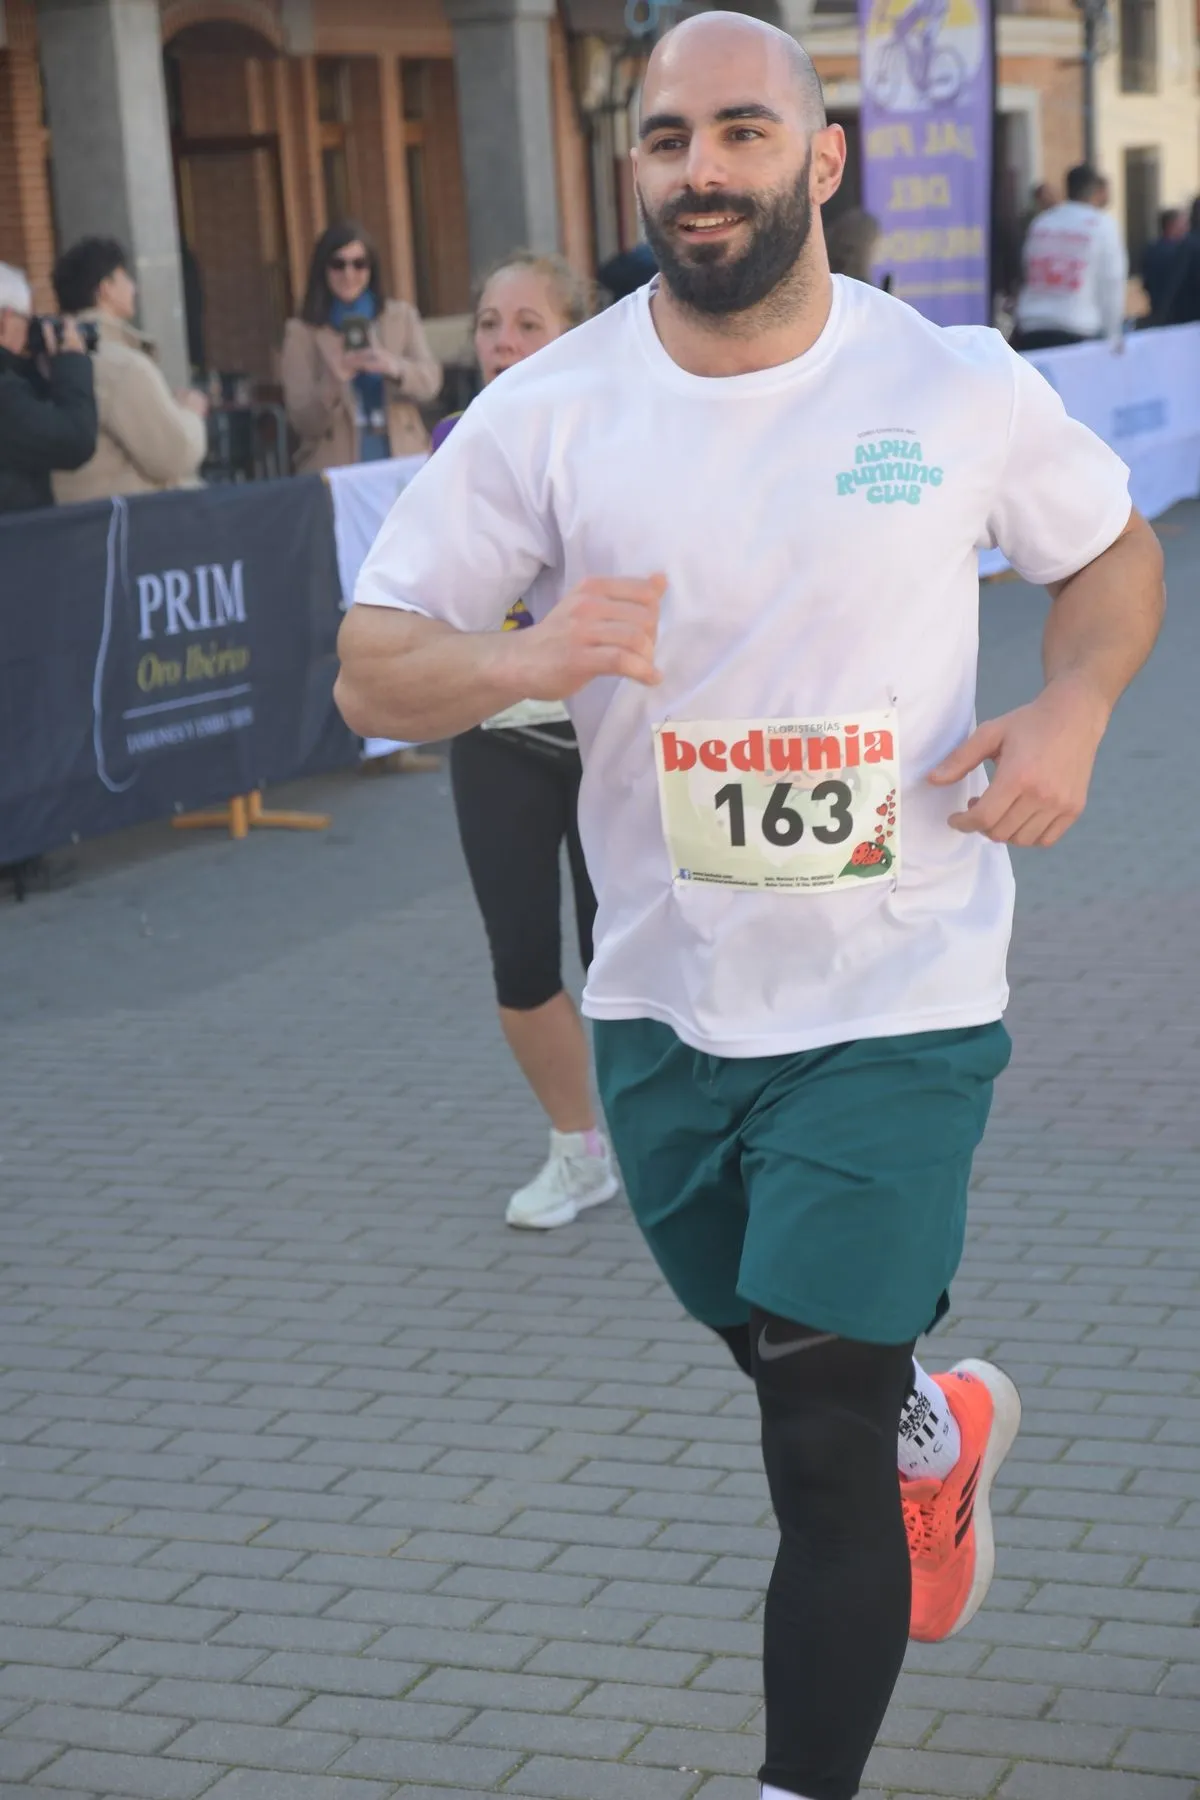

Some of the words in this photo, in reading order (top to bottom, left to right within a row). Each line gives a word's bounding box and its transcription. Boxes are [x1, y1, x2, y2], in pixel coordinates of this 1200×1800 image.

[855, 440, 923, 464] ALPHA
[867, 484, 921, 505] CLUB
[136, 559, 247, 640] PRIM
[137, 651, 182, 692] Oro
[661, 724, 895, 773] bedunia
[714, 779, 854, 847] 163
